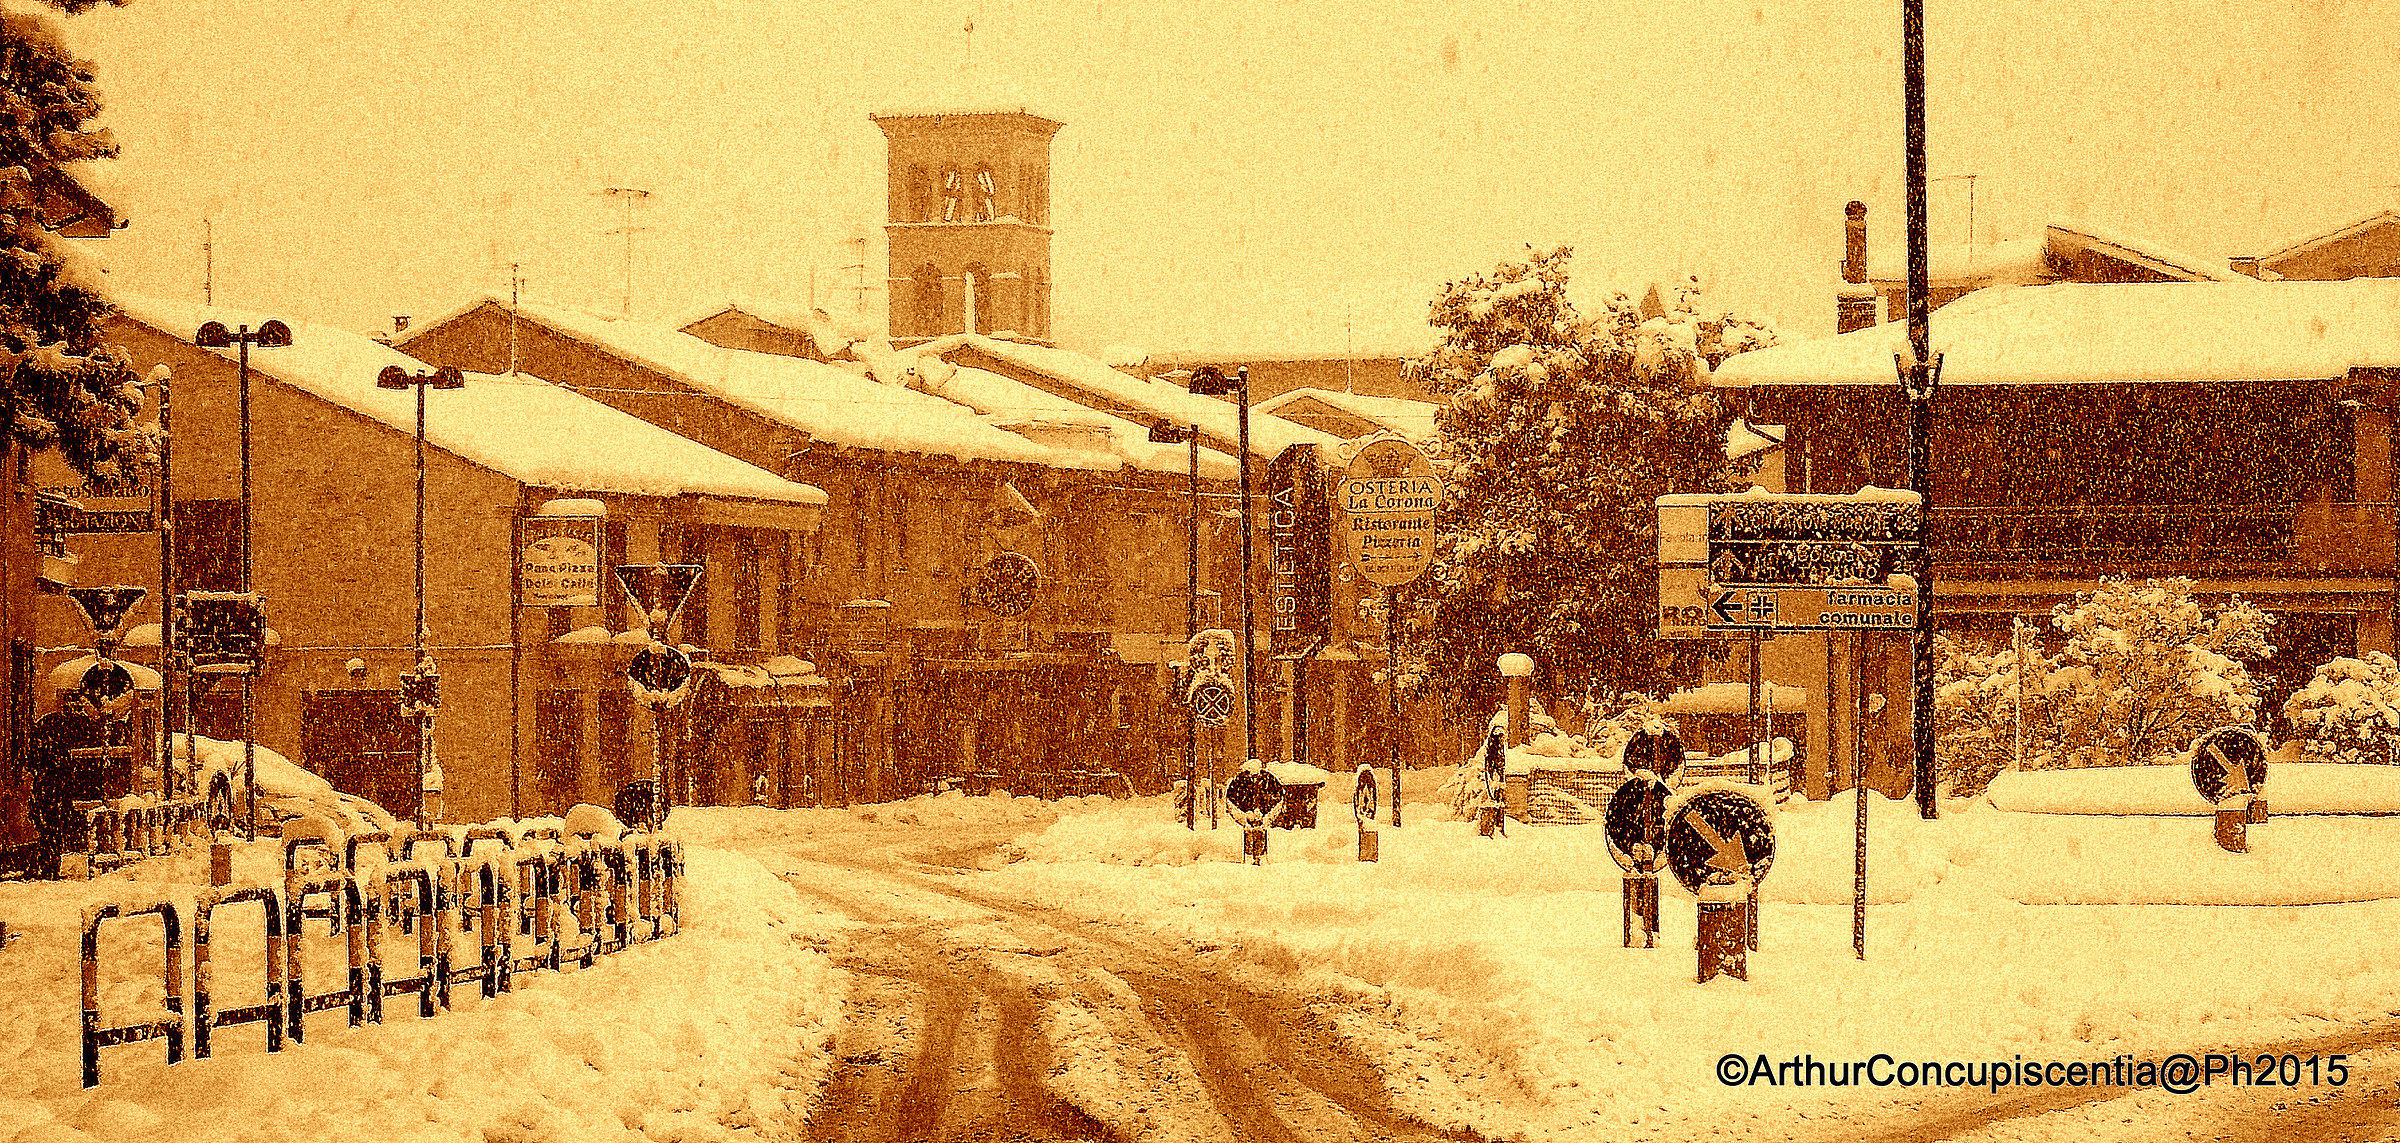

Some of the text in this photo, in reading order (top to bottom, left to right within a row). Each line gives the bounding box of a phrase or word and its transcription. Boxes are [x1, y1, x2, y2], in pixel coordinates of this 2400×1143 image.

[1349, 481, 1433, 495] OSTERIA
[1349, 495, 1434, 509] La Corona
[1351, 517, 1431, 531] Ristorante
[1362, 535, 1421, 549] Pizzeria
[1274, 487, 1296, 631] ESTETICA
[558, 562, 595, 574] Pizza
[1828, 590, 1912, 606] farmacia
[1820, 610, 1913, 625] comunale
